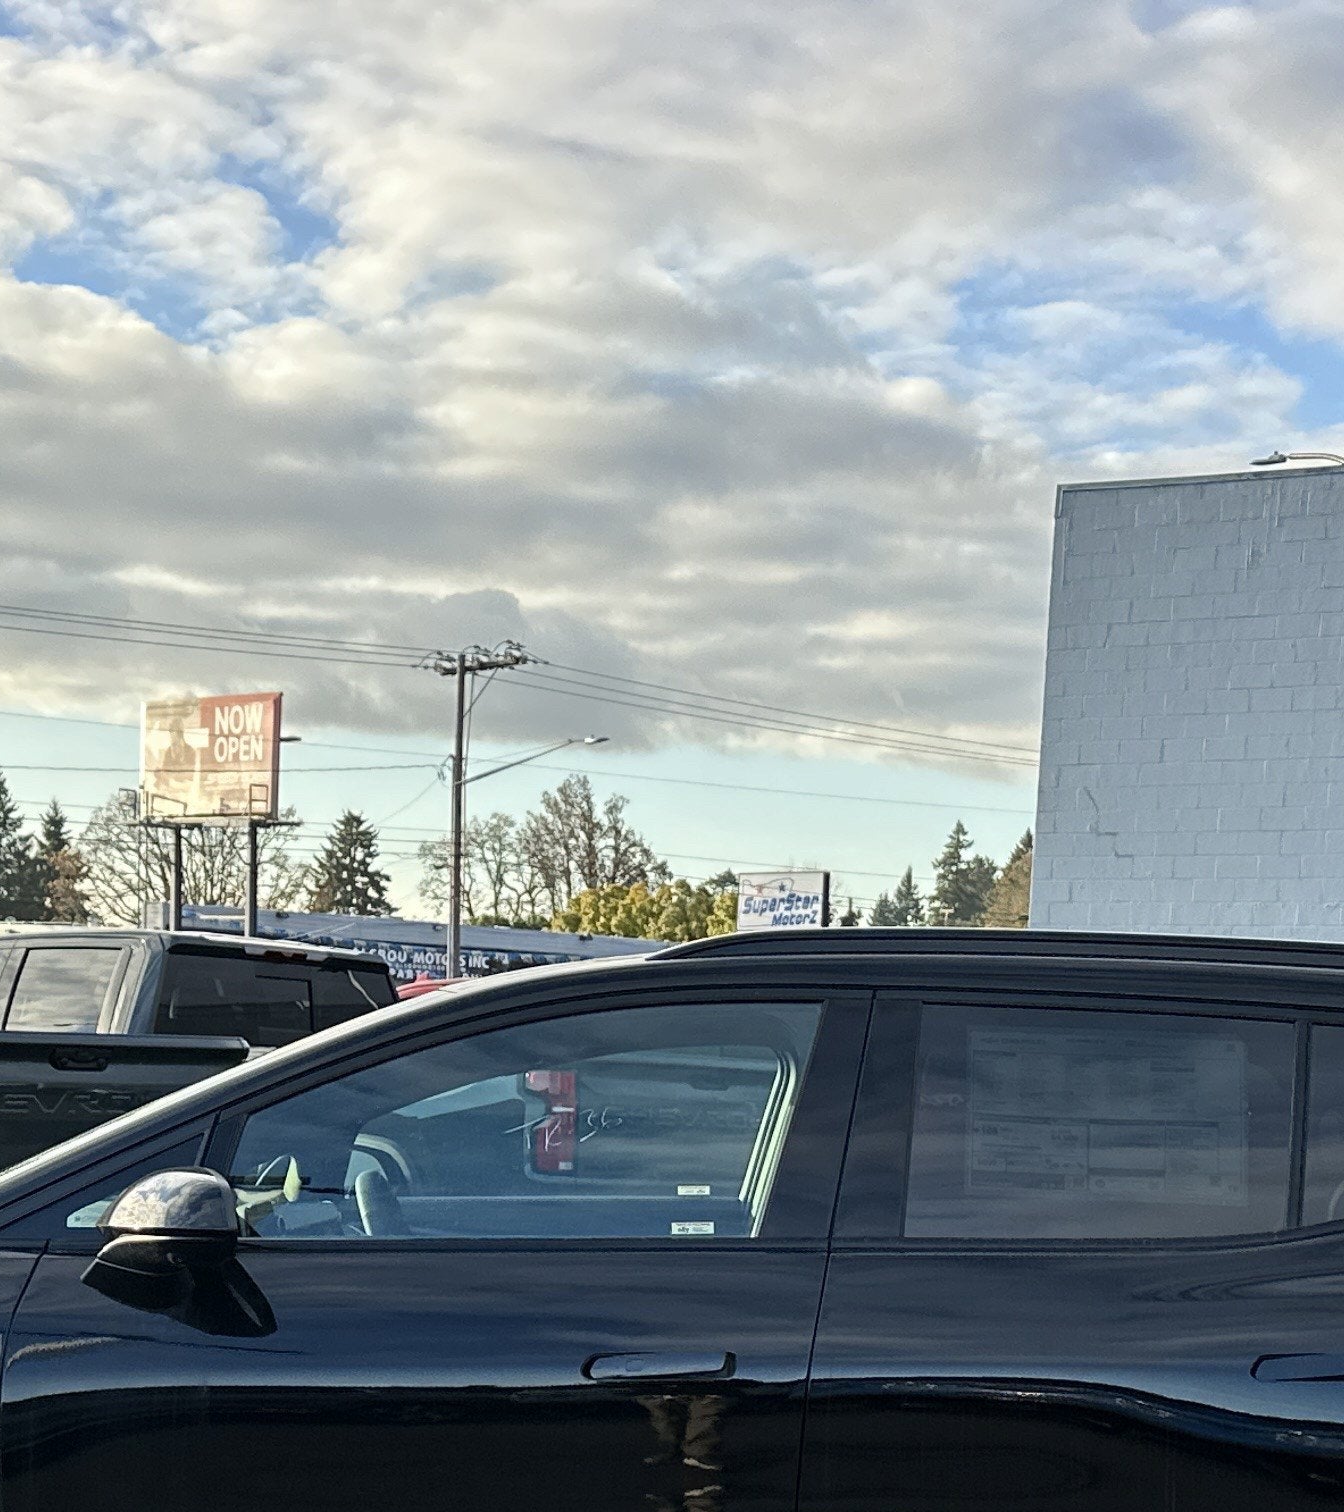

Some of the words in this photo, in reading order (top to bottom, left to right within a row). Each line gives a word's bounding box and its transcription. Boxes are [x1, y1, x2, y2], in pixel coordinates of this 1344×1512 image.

[214, 702, 264, 735] NOW
[214, 734, 264, 763] OPEN
[742, 893, 820, 917] SuperStar
[771, 910, 819, 927] MotorZ
[412, 948, 466, 967] MOTOS
[468, 954, 490, 969] INC
